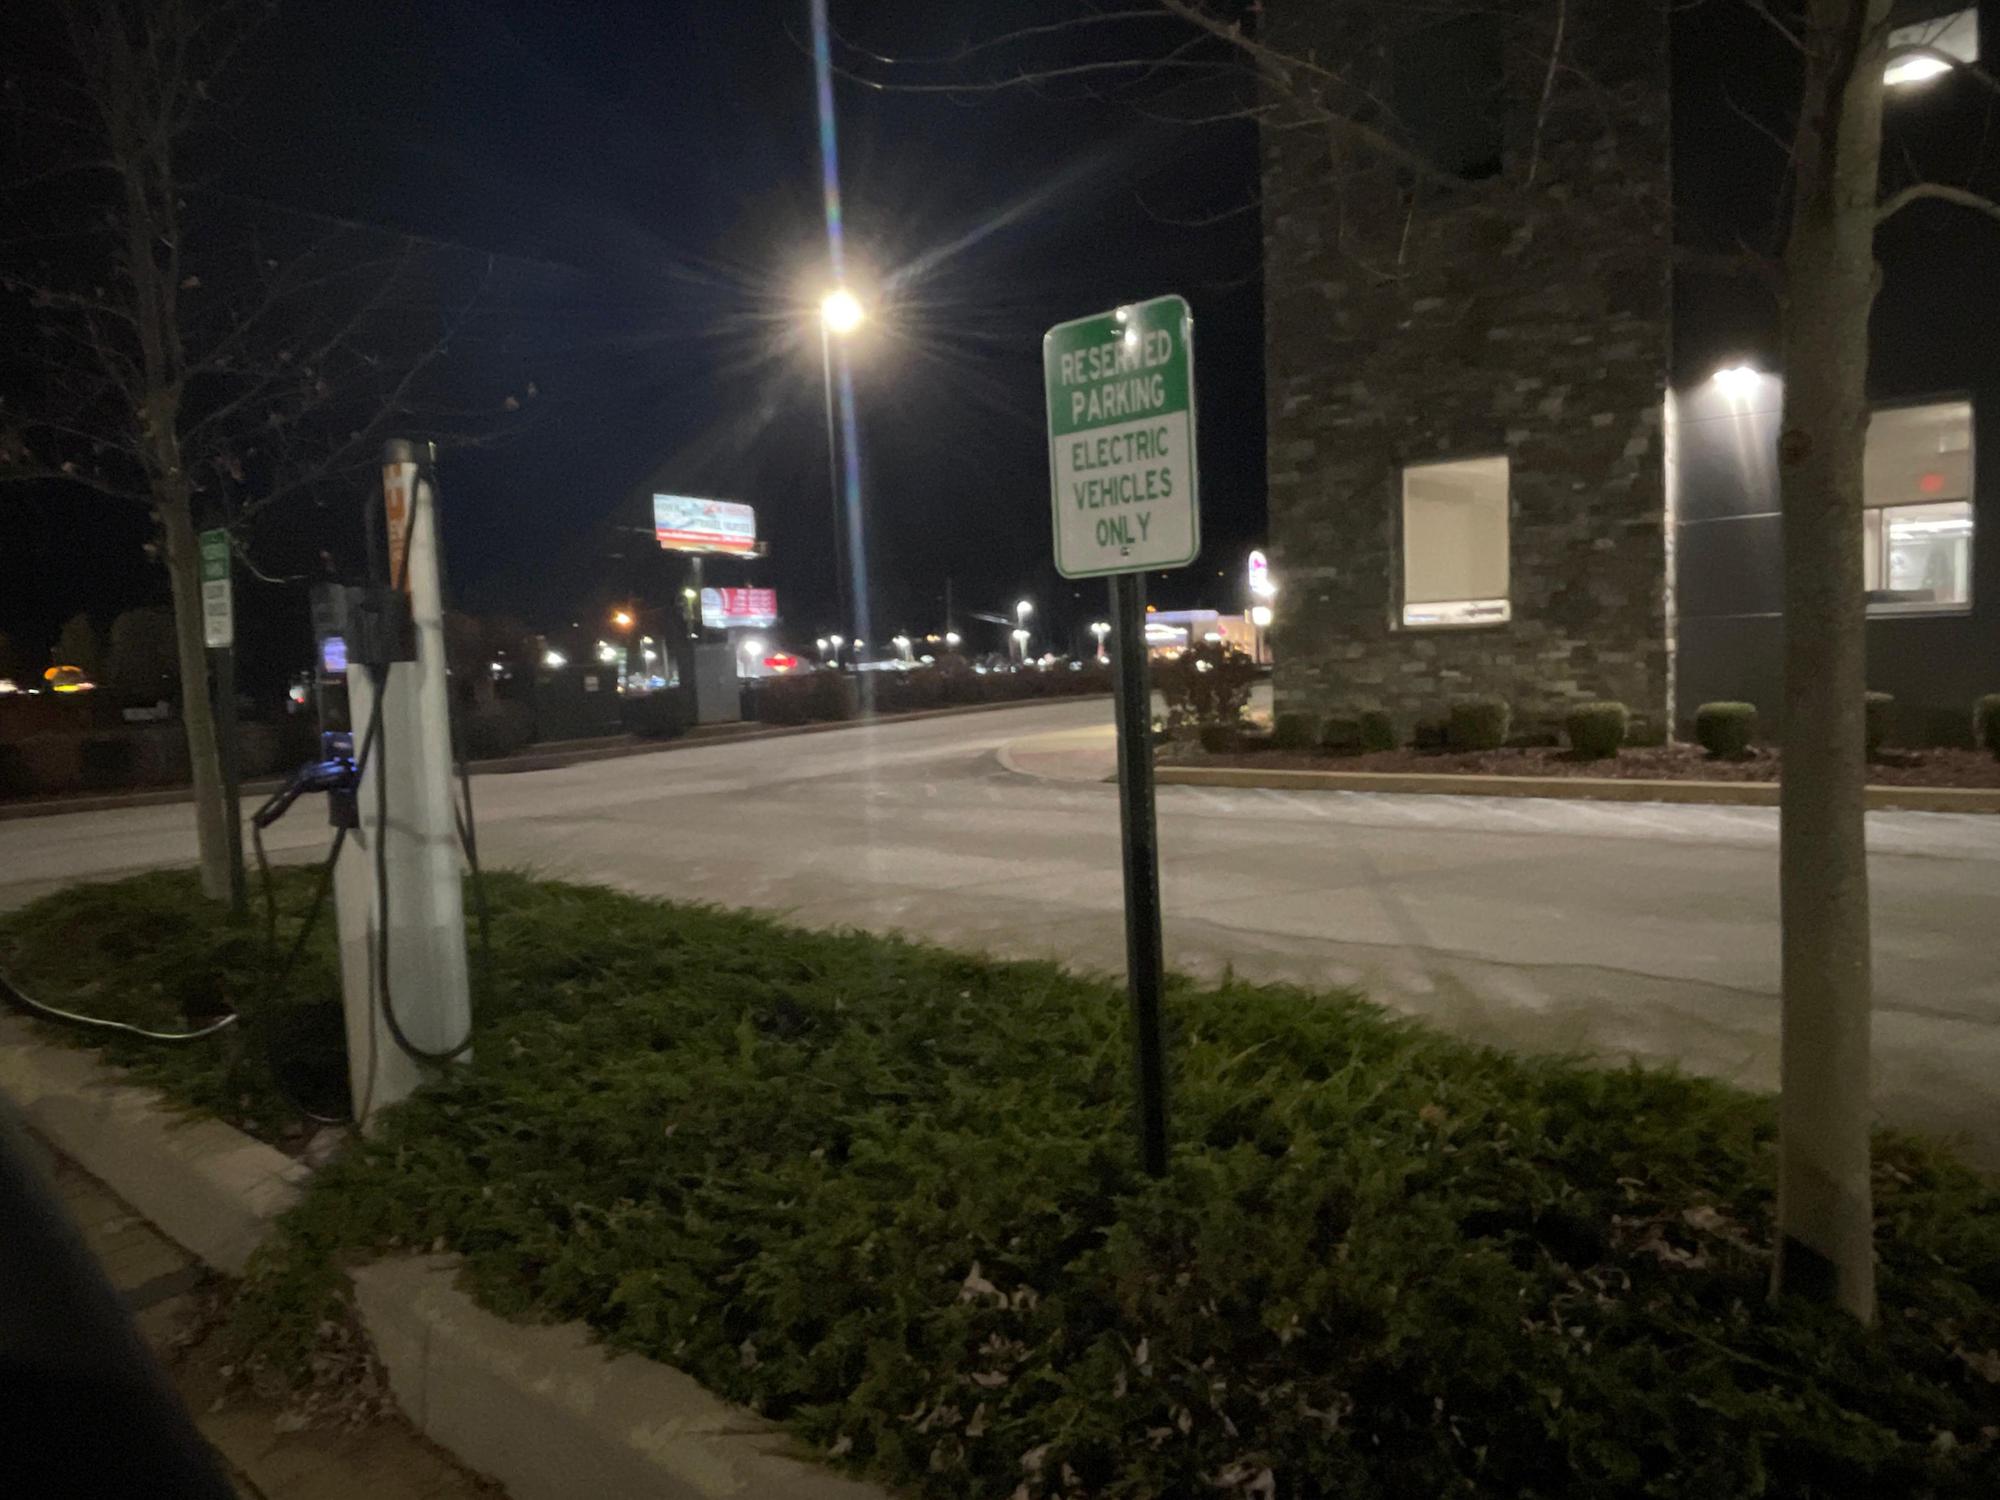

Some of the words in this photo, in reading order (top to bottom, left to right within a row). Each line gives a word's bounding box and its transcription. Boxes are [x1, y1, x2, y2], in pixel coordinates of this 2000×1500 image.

[1071, 373, 1165, 425] PARKING
[1071, 426, 1169, 472] ELECTRIC
[1073, 467, 1172, 511] VEHICLES
[1096, 512, 1151, 547] ONLY
